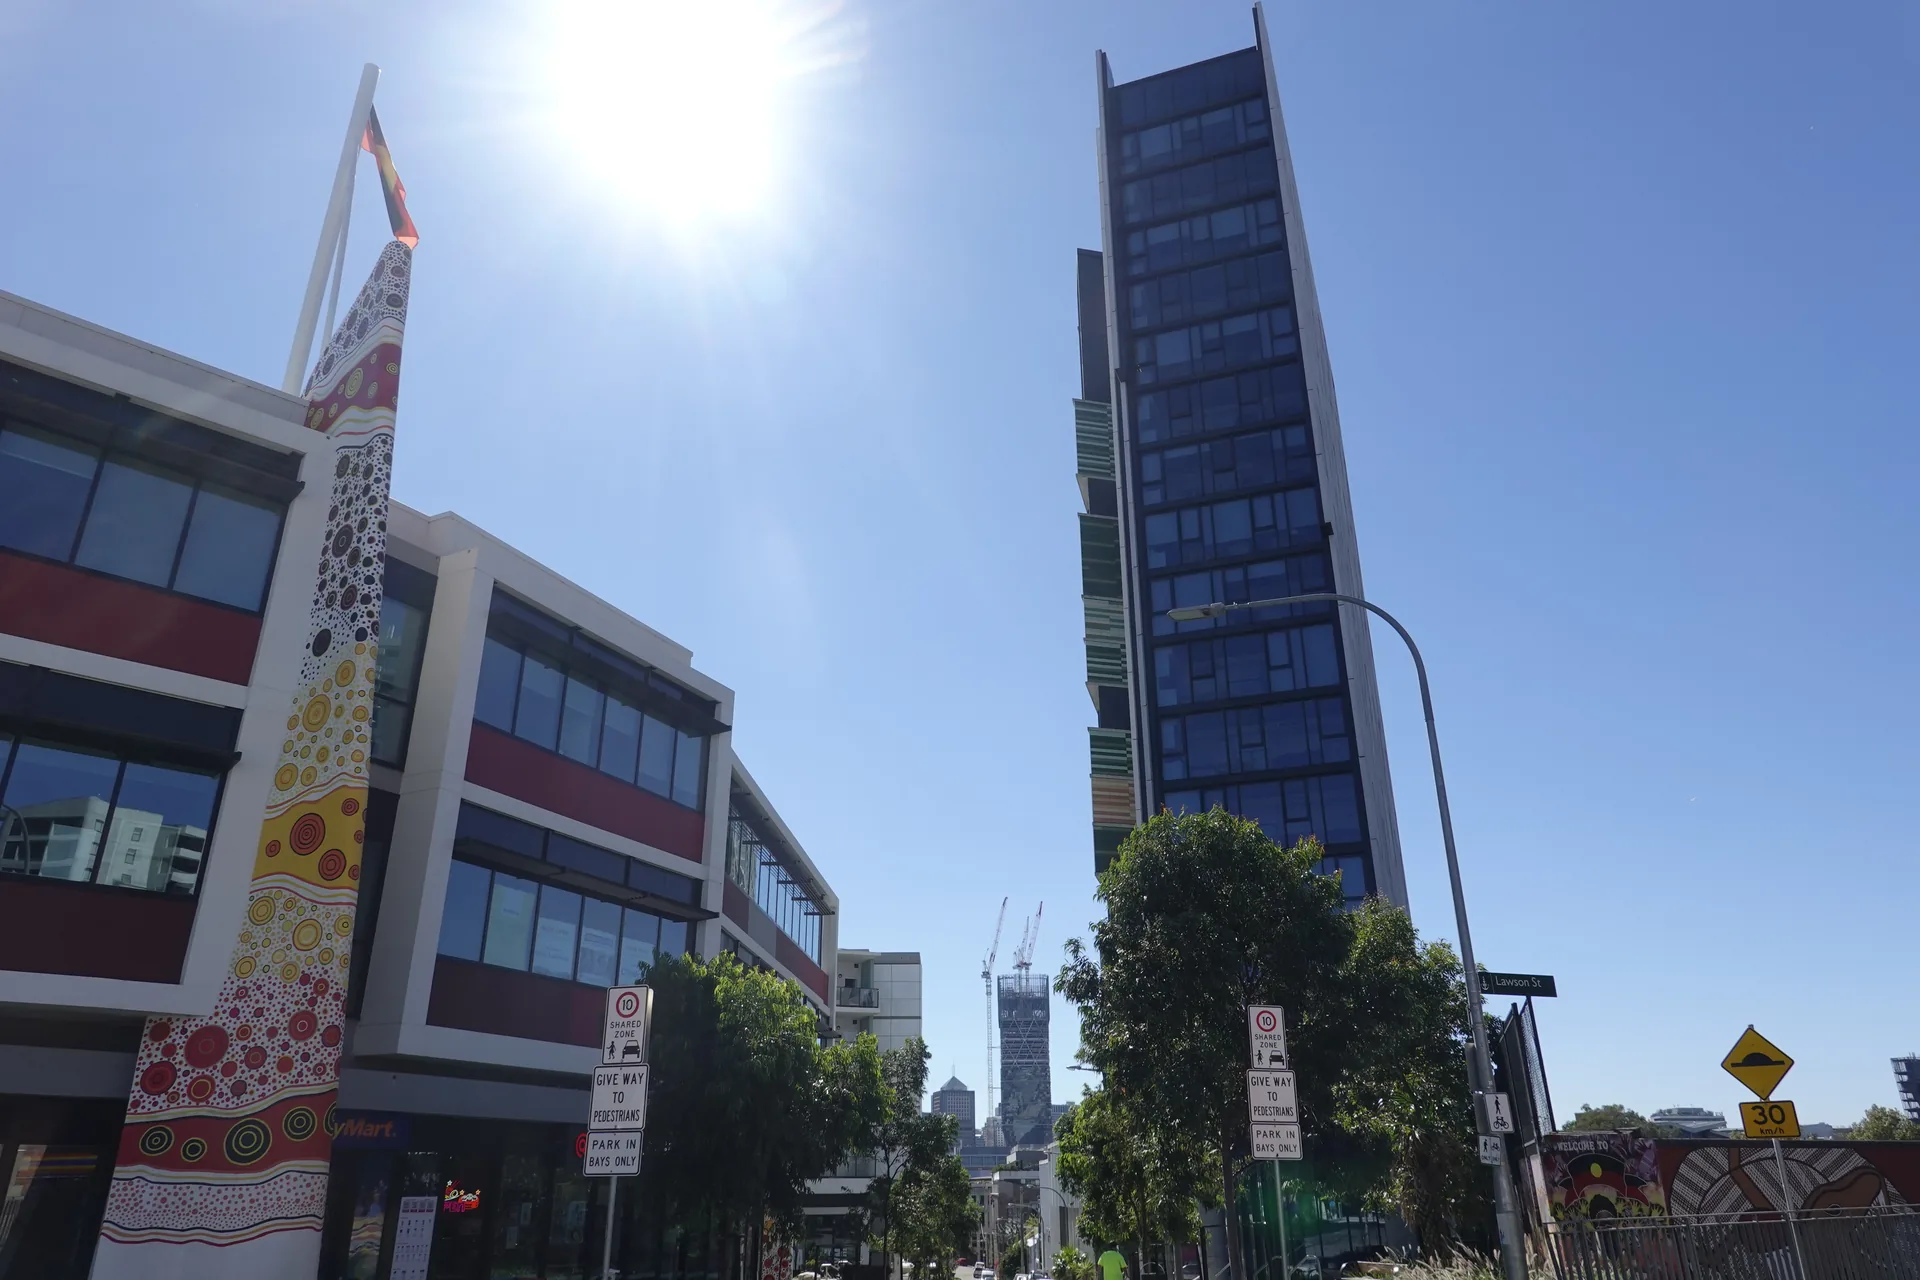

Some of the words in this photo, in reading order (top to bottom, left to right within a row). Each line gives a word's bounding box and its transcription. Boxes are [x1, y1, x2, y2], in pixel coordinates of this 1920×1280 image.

[1495, 975, 1530, 988] Lawson
[1531, 976, 1542, 988] St
[622, 998, 633, 1011] 10
[610, 1020, 642, 1029] SHARED
[1262, 1016, 1272, 1026] 10
[614, 1030, 636, 1038] ZONE
[1254, 1033, 1282, 1041] SHARED
[1259, 1041, 1278, 1049] ZONE
[596, 1073, 619, 1086] GIVE
[622, 1072, 644, 1085] WAY
[1251, 1076, 1270, 1087] GIVE
[1273, 1076, 1292, 1087] WAY
[613, 1091, 625, 1104] TO
[1267, 1091, 1278, 1102] TO
[593, 1109, 640, 1123] PEDESTRIANS
[1253, 1105, 1294, 1117] PEDESTRIANS
[1751, 1105, 1785, 1125] 30
[332, 1119, 393, 1140] yMart
[1256, 1130, 1281, 1139] PARK
[1286, 1130, 1295, 1139] IN
[1760, 1127, 1785, 1135] km/h
[592, 1139, 621, 1150] PARK
[626, 1138, 637, 1149] IN
[1255, 1143, 1275, 1152] BAYS
[1278, 1143, 1298, 1152] ONLY
[1557, 1140, 1596, 1153] WELCOME
[1597, 1140, 1609, 1152] TO
[589, 1156, 611, 1167] BAYS
[614, 1155, 637, 1167] ONLY
